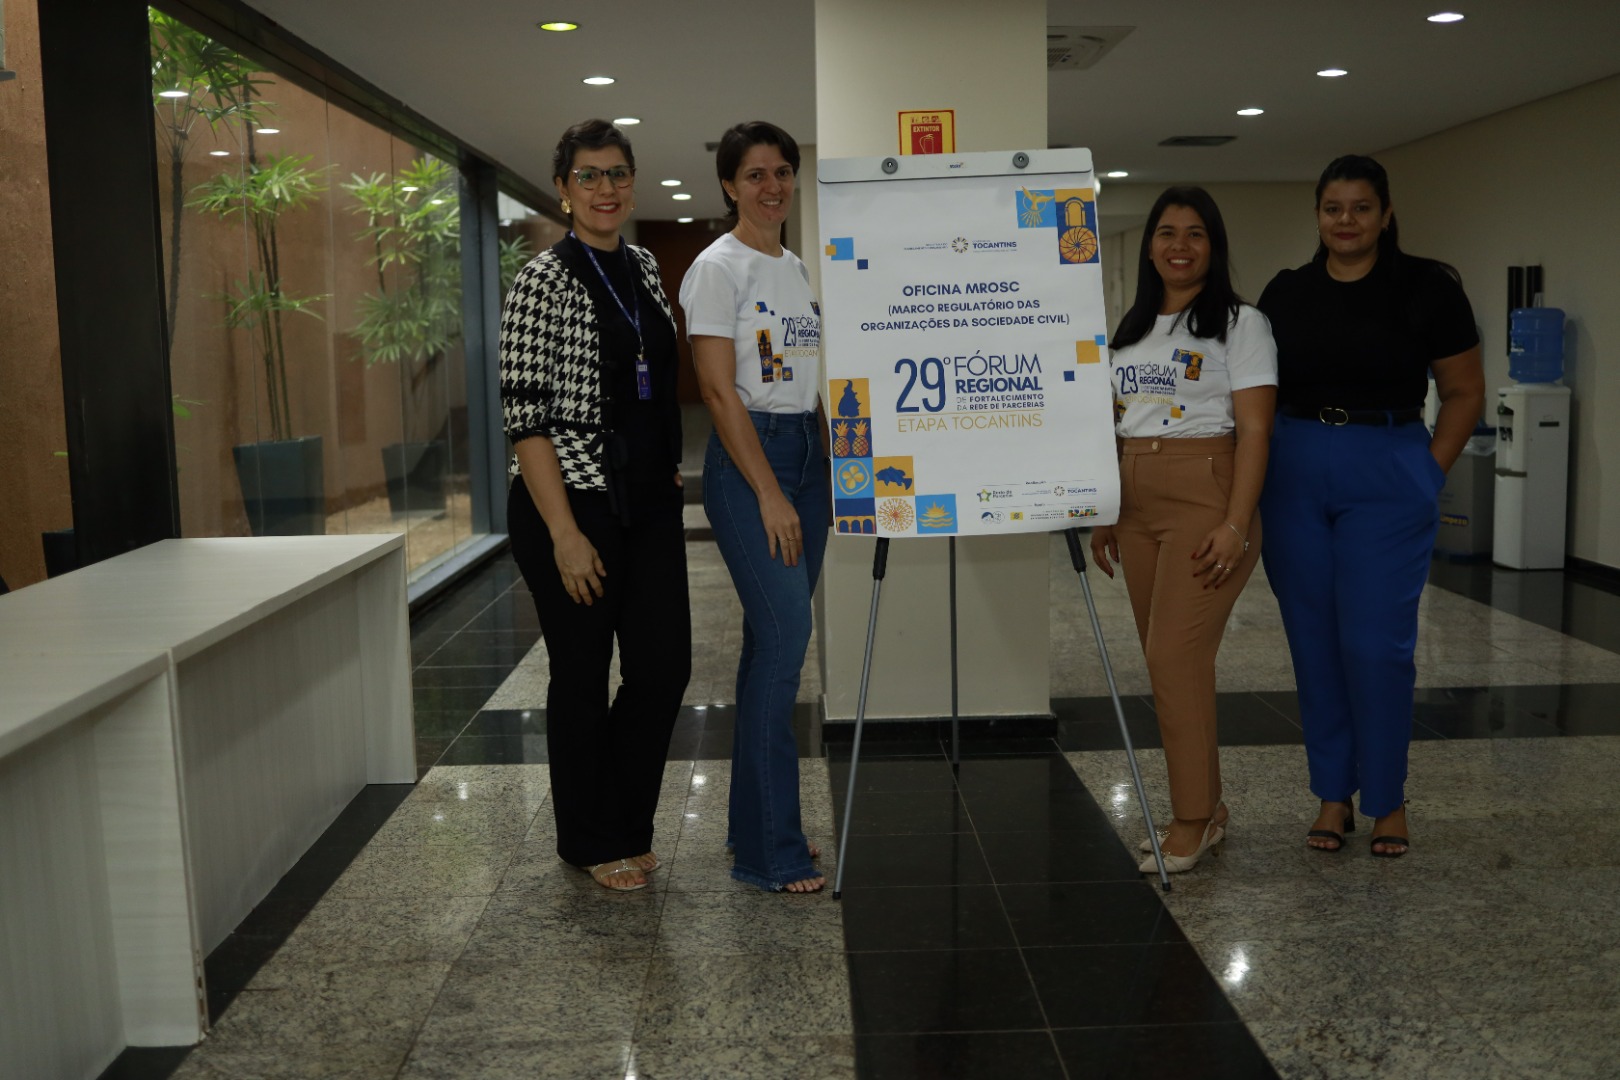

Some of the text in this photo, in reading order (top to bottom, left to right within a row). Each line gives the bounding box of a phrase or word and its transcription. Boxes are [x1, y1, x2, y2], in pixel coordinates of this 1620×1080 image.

[912, 125, 940, 133] EXTINTOR
[972, 241, 1018, 249] TOCANTINS
[902, 280, 1020, 297] OFICINA MROSC
[888, 299, 1040, 317] (MARCO REGULATÓRIO DAS
[861, 313, 1070, 332] ORGANIZAÇÕES DA SOCIEDADE CIVIL)
[954, 349, 1042, 377] FÓRUM
[1139, 361, 1177, 379] FÓRUM
[955, 376, 1043, 394] REGIONAL
[1139, 376, 1176, 387] REGIONAL
[956, 394, 1044, 404] DE FORTALECIMENTO
[969, 403, 988, 411] REDE
[1002, 401, 1045, 409] PARCERIAS
[897, 413, 1043, 433] ETAPA TOCANTINS
